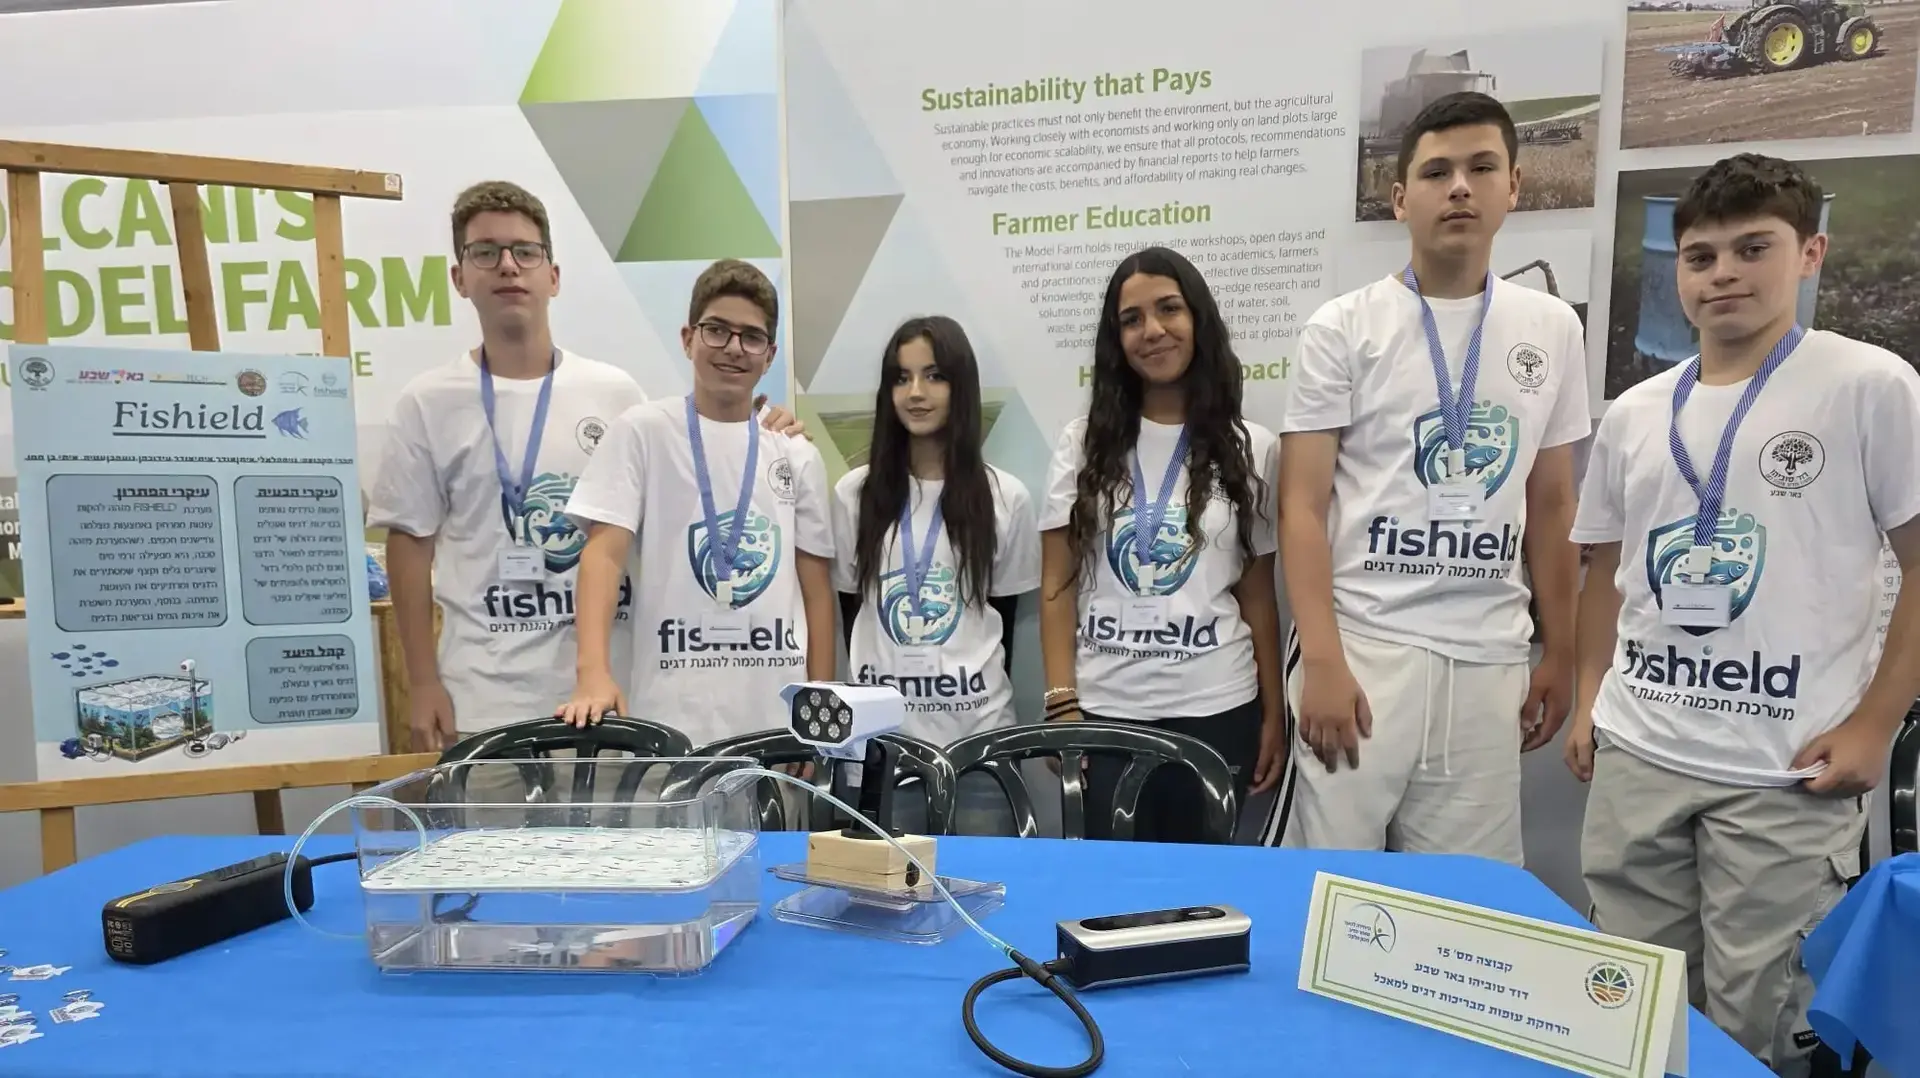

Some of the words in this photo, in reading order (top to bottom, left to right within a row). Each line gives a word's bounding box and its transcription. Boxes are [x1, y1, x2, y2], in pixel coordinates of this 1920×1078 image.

[921, 77, 1087, 112] Sustainability
[1094, 71, 1145, 98] that
[1152, 67, 1212, 96] Pays
[934, 119, 989, 135] Sustainable
[992, 116, 1035, 132] practices
[1038, 115, 1062, 127] must
[1065, 114, 1081, 124] not
[1084, 111, 1105, 127] only
[1107, 108, 1142, 121] benefit
[1145, 106, 1162, 118] the
[1164, 101, 1231, 116] environment,
[1234, 99, 1251, 111] but
[1255, 98, 1271, 109] the
[1274, 92, 1334, 108] agricultural
[991, 134, 1030, 147] Working
[1033, 130, 1066, 145] closely
[1069, 128, 1090, 140] with
[1092, 124, 1149, 139] economists
[1152, 121, 1171, 133] and
[1174, 118, 1214, 132] working
[1217, 115, 1239, 130] only
[1241, 117, 1255, 126] on
[1257, 113, 1279, 125] land
[1282, 111, 1308, 125] plots
[1311, 110, 1338, 123] large
[951, 154, 987, 166] enough
[989, 151, 1002, 162] for
[1005, 149, 1051, 161] economic
[1054, 142, 1104, 157] scalability,
[1107, 144, 1121, 153] we
[1123, 140, 1158, 152] ensure
[1161, 137, 1181, 149] that
[1184, 135, 1195, 147] all
[1198, 132, 1248, 149] protocols,
[1251, 126, 1346, 143] recommendations
[959, 169, 977, 181] and
[979, 165, 1034, 180] innovations
[1037, 165, 1053, 175] are
[1055, 159, 1121, 175] accompanied
[1123, 158, 1136, 171] by
[1138, 153, 1179, 166] financial
[1181, 151, 1218, 165] reports
[1221, 151, 1232, 161] to
[1234, 149, 1257, 162] help
[1259, 146, 1300, 159] farmers
[968, 182, 1009, 197] navigate
[1011, 181, 1028, 192] the
[1103, 174, 1122, 186] and
[1124, 169, 1183, 185] affordability
[1186, 169, 1197, 181] of
[1199, 165, 1237, 180] making
[1239, 165, 1259, 176] real
[992, 211, 1079, 236] Farmer
[1086, 200, 1212, 230] Education
[1005, 247, 1023, 258] The
[1025, 244, 1055, 257] Model
[1057, 243, 1083, 255] Farm
[1085, 241, 1111, 253] holds
[1114, 239, 1148, 253] regular
[1190, 233, 1247, 248] workshops,
[1250, 232, 1275, 245] open
[1278, 229, 1302, 244] days
[1305, 228, 1325, 240] and
[1012, 260, 1073, 274] international
[1207, 252, 1217, 262] to
[1220, 249, 1276, 262] academics,
[1279, 246, 1319, 258] farmers
[1021, 277, 1039, 289] and
[1041, 274, 1101, 288] practitioners
[1204, 266, 1249, 278] effective
[1251, 262, 1323, 276] dissemination
[221, 256, 452, 331] FARM
[1030, 293, 1039, 304] of
[1254, 278, 1298, 291] research
[1300, 278, 1320, 290] and
[1038, 307, 1081, 319] solutions
[1083, 308, 1096, 317] on
[1224, 298, 1235, 309] of
[1237, 313, 1260, 326] they
[1263, 313, 1281, 323] can
[1284, 311, 1297, 322] be
[1055, 336, 1096, 349] adopted
[1249, 330, 1259, 340] at
[1262, 327, 1293, 341] global
[113, 402, 265, 431] Fishield
[117, 487, 168, 501] הפתרון
[172, 487, 210, 501] עיקרי
[257, 488, 299, 498] הבעיה
[302, 488, 338, 501] עיקרי
[1368, 516, 1521, 562] fishield
[1363, 559, 1395, 572] דגים
[1398, 562, 1445, 576] להגנת
[1448, 565, 1486, 579] חכמה
[489, 622, 516, 633] דגים
[318, 645, 346, 660] קהל
[768, 654, 805, 668] מערכת
[1132, 649, 1170, 660] חכמה
[660, 658, 686, 670] דגים
[690, 655, 729, 669] להגנת
[733, 656, 765, 668] חכמה
[1622, 639, 1801, 699] fishield
[1636, 686, 1682, 704] להגנת
[1682, 694, 1732, 712] חכמה
[918, 701, 951, 713] חכמה
[1735, 700, 1795, 721] מערכת
[1437, 946, 1451, 958] 15
[1414, 962, 1440, 976] שבע
[1476, 955, 1513, 973] קבוצה
[1374, 972, 1408, 991] למאכל
[1443, 970, 1465, 983] באר
[1468, 977, 1505, 994] טוביהו
[1411, 984, 1436, 998] דגים
[1509, 988, 1529, 1001] דוד
[1439, 992, 1485, 1012] מבריכות
[1488, 1005, 1523, 1022] עופות
[1526, 1016, 1571, 1036] הרחקת
